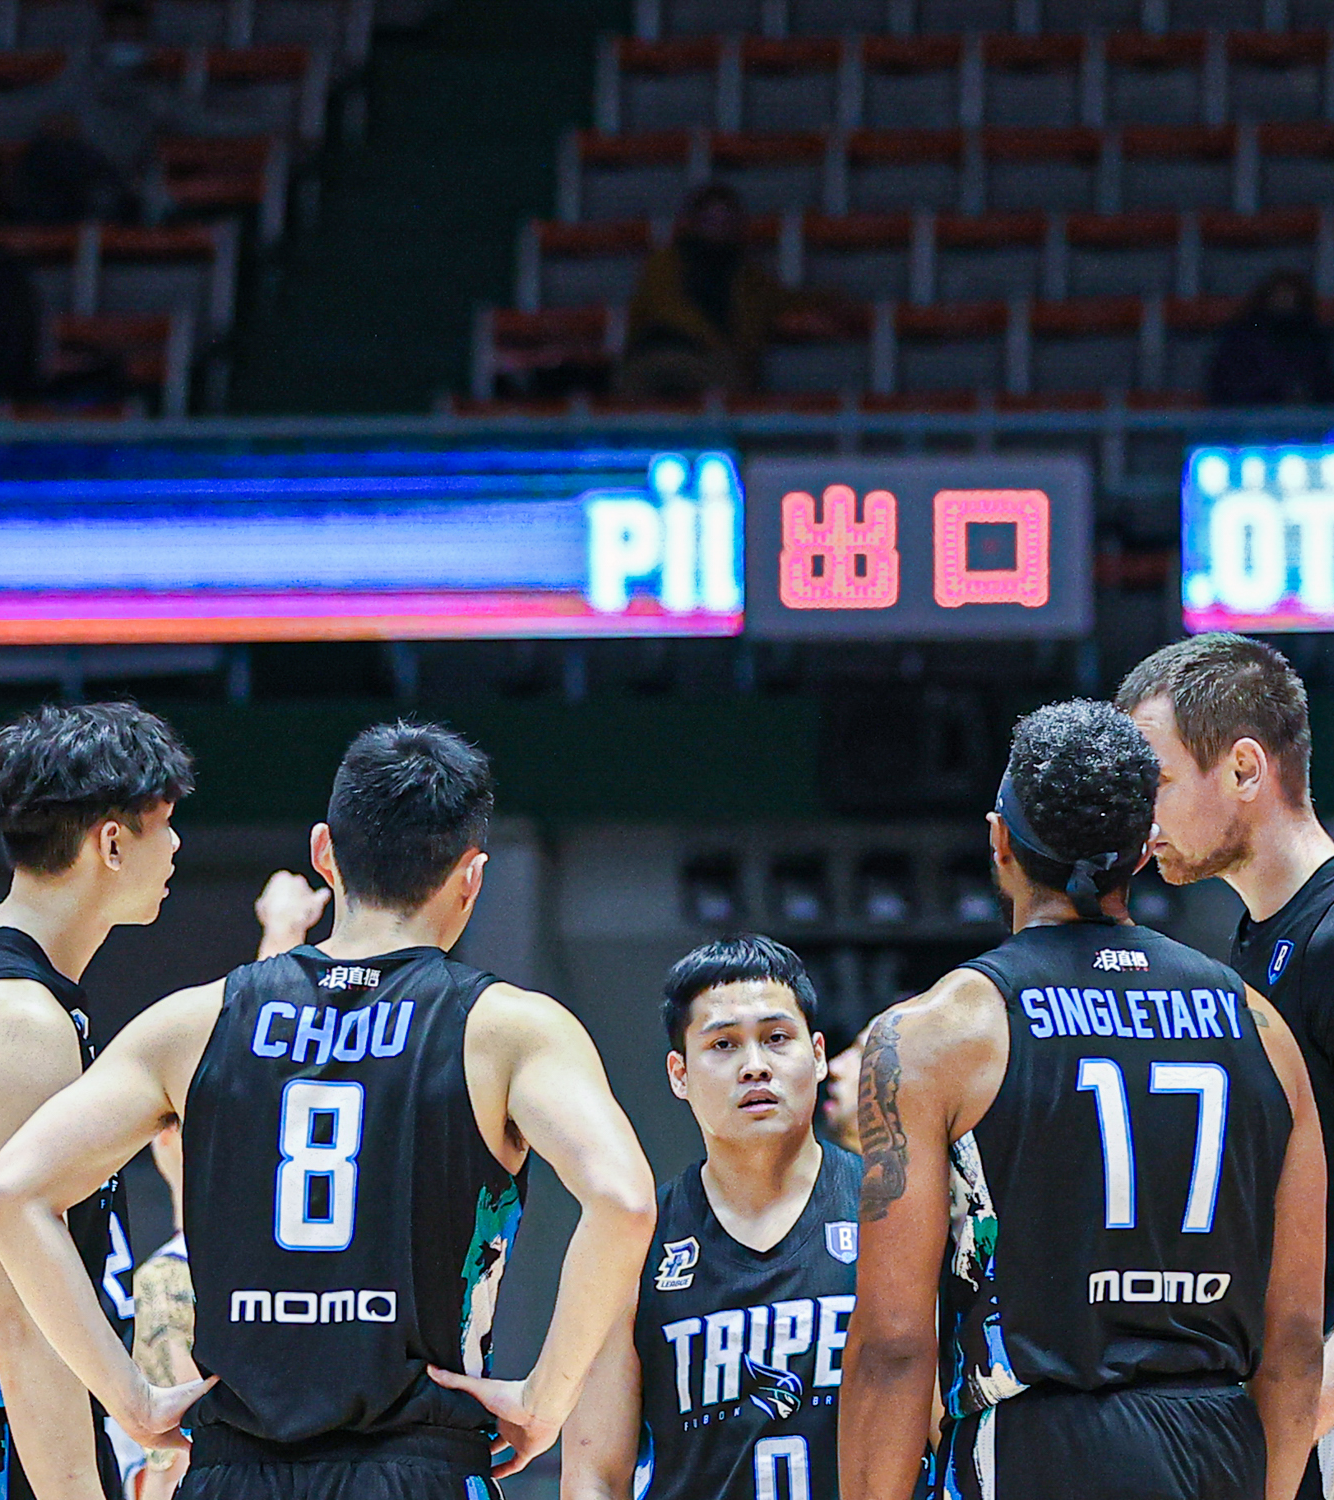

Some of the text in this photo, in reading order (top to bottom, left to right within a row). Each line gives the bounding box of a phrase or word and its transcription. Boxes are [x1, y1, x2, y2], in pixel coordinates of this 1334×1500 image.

[780, 484, 1051, 609] 出口
[251, 1000, 415, 1065] CHOU
[1020, 986, 1243, 1039] SINGLETARY
[273, 1078, 367, 1252] 8
[1076, 1057, 1231, 1234] 17
